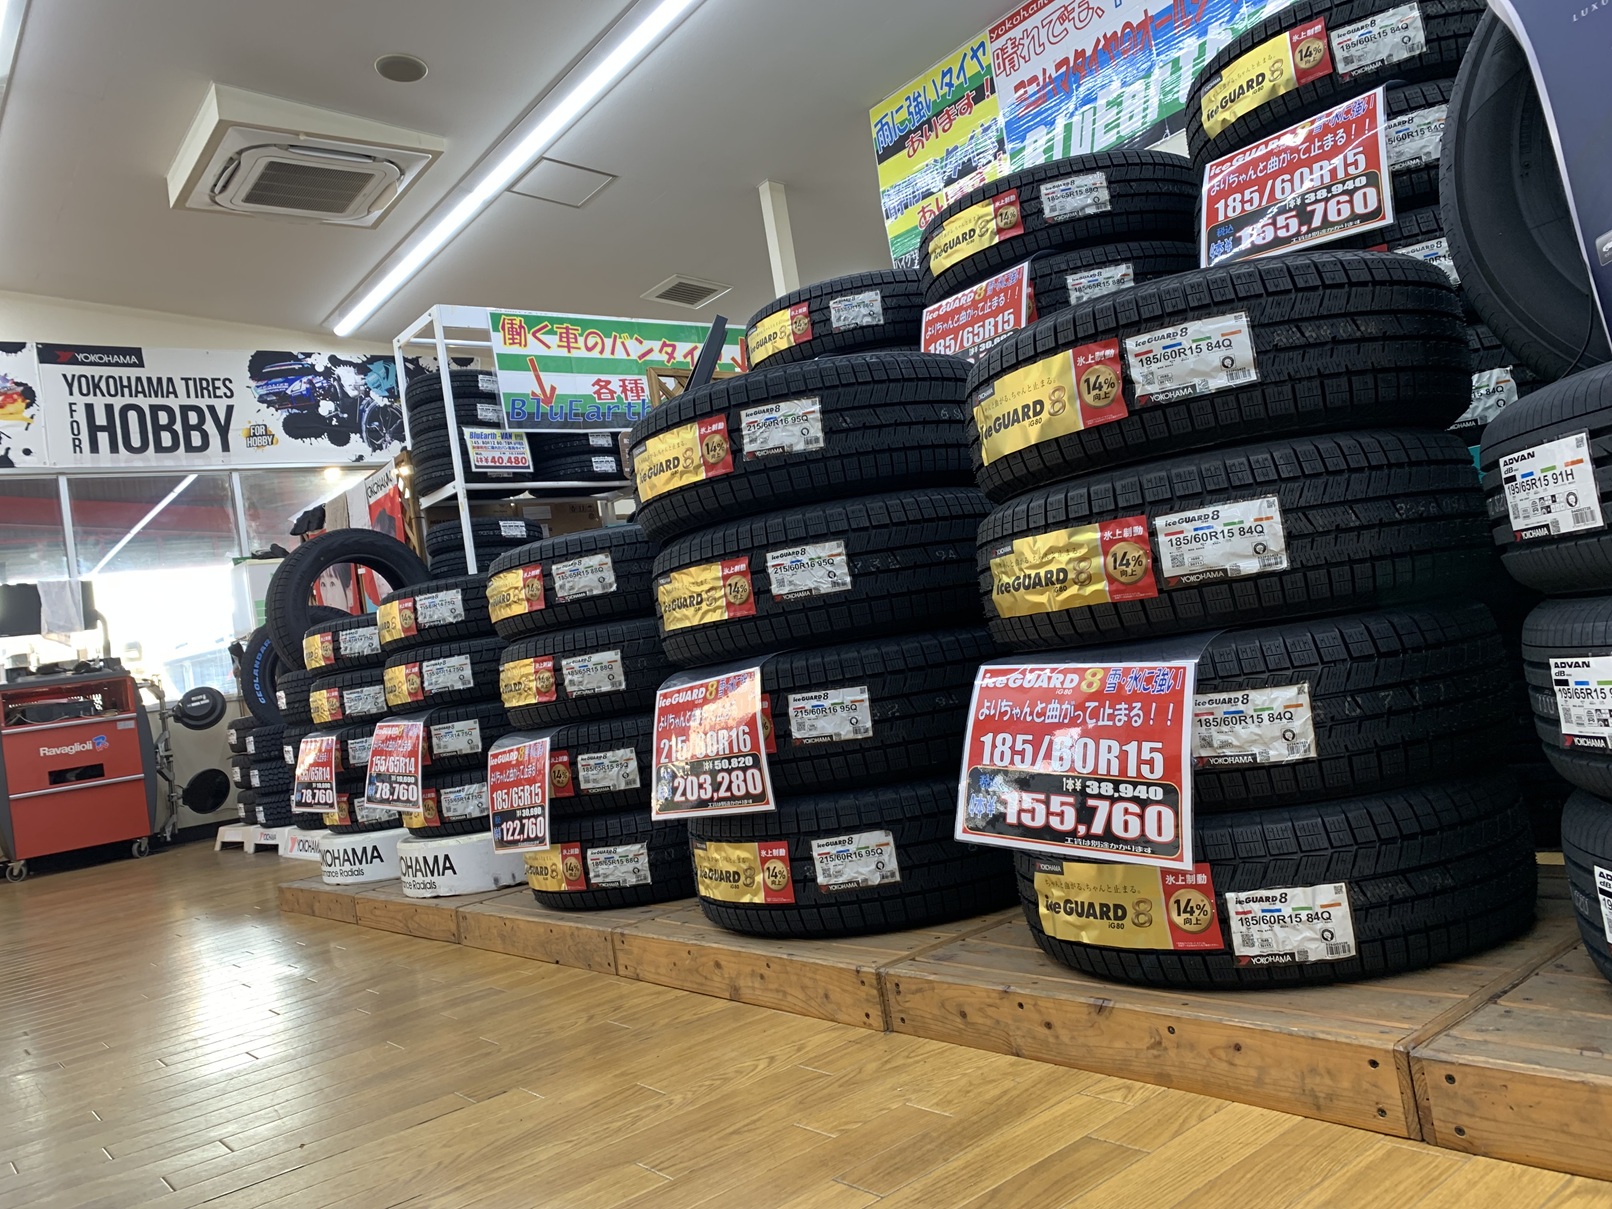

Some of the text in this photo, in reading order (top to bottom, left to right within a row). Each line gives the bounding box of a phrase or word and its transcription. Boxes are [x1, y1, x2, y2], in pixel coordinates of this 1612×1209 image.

[1339, 22, 1409, 52] 185/60R15 84Q
[1298, 43, 1322, 61] 14%
[1351, 61, 1383, 77] YOKOHAMA
[873, 40, 986, 155] 雨に強いタイヤ
[1214, 146, 1366, 221] 185/60R15
[1304, 176, 1367, 204] 38,940
[998, 211, 1016, 223] 14%
[1234, 187, 1378, 248] 155,760
[932, 228, 976, 262] iceGUARD
[925, 284, 986, 322] iceGUARD 8
[928, 309, 1014, 354] 185/65R15
[1134, 326, 1189, 348] iceGUARD 8
[500, 316, 722, 369] 働く車のバンタイ
[74, 351, 139, 365] YOKOHAMA
[1137, 337, 1233, 368] 185/60R15 84Q
[61, 373, 177, 399] YOKOHAMA
[180, 376, 234, 399] TIRES
[591, 377, 666, 402] 各種
[1084, 372, 1116, 397] 14%
[1485, 385, 1505, 396] 84Q
[1047, 385, 1067, 417] 8
[1092, 391, 1111, 402] 向上
[1149, 386, 1194, 402] YOKOHAMA
[510, 398, 652, 422] BluEarth
[70, 402, 82, 454] FOR
[87, 403, 235, 454] HOBBY
[250, 425, 265, 435] FOR
[746, 414, 809, 432] 215/60R16 95Q
[246, 434, 274, 447] HOBBY
[704, 440, 726, 456] 14%
[754, 447, 783, 457] YOKOHAMA
[1502, 450, 1536, 468] ADVAN
[1504, 467, 1514, 475] dB
[1507, 468, 1575, 496] 195/65R15 91H
[1164, 509, 1221, 527] iceGUARD 8
[1102, 525, 1144, 542] 氷上制動
[1167, 523, 1266, 549] 185/60R15 84Q
[1520, 527, 1550, 540] YOKOHAMA
[773, 557, 835, 575] 215/60R16 95Q
[1110, 552, 1144, 571] 14%
[996, 557, 1093, 596] iceGUARD 8
[1119, 569, 1138, 578] 向上
[1179, 570, 1226, 584] YOKOHAMA
[726, 582, 748, 595] 14%
[781, 590, 811, 601] YOKOHAMA
[980, 668, 1183, 695] iceGUARD 8 雪・氷に強い
[658, 687, 706, 708] iceGUARD
[706, 680, 717, 700] 8
[792, 692, 829, 703] iceGUARD 8
[1194, 693, 1250, 707] iceGUARD 8
[1558, 687, 1607, 700] 195/65R15
[793, 703, 858, 718] 215/60R16 95Q
[978, 699, 1175, 727] よりちゃんと曲がって止まる！！
[1196, 710, 1294, 729] 185/60R15 84Q
[39, 740, 93, 757] Ravaglioli
[802, 735, 832, 745] YOKOHAMA
[1573, 737, 1606, 747] YOKOHAMA
[372, 756, 415, 774] 155/65R14
[490, 751, 518, 766] iceGUARD
[714, 756, 753, 770] 50,820
[1208, 755, 1254, 765] YOKOHAMA
[552, 768, 568, 780] 14%
[582, 764, 614, 773] 185/65R15
[376, 782, 418, 801] 78,760
[673, 768, 764, 803] 203,280
[1085, 780, 1164, 801] 38,940
[301, 789, 333, 804] 78,760
[492, 783, 542, 811] 185/65R15
[521, 806, 542, 817] 30,690
[1001, 791, 1177, 844] 155,760
[501, 816, 545, 842] 122,760
[816, 836, 854, 849] iceGUARD 8
[1064, 836, 1153, 854] 工賃は別途かかります
[591, 857, 625, 867] 185/65R15
[818, 847, 884, 864] 215/60R16 95Q
[339, 866, 365, 877] Radials
[400, 853, 458, 878] OHAMA
[564, 862, 580, 873] 14%
[766, 865, 787, 881] 14%
[412, 879, 437, 890] Radials
[828, 881, 858, 892] YOKOHAMA
[1165, 873, 1208, 886] 氷上制動
[1234, 892, 1288, 905] iceGUARD 8
[1044, 894, 1153, 928] iceGUARD 8
[1173, 897, 1209, 918] 14%
[1107, 921, 1125, 930] iG80
[1182, 916, 1202, 926] 向上
[1237, 909, 1332, 928] 185/60R15 84Q
[1250, 953, 1293, 965] YOKOHAMA
